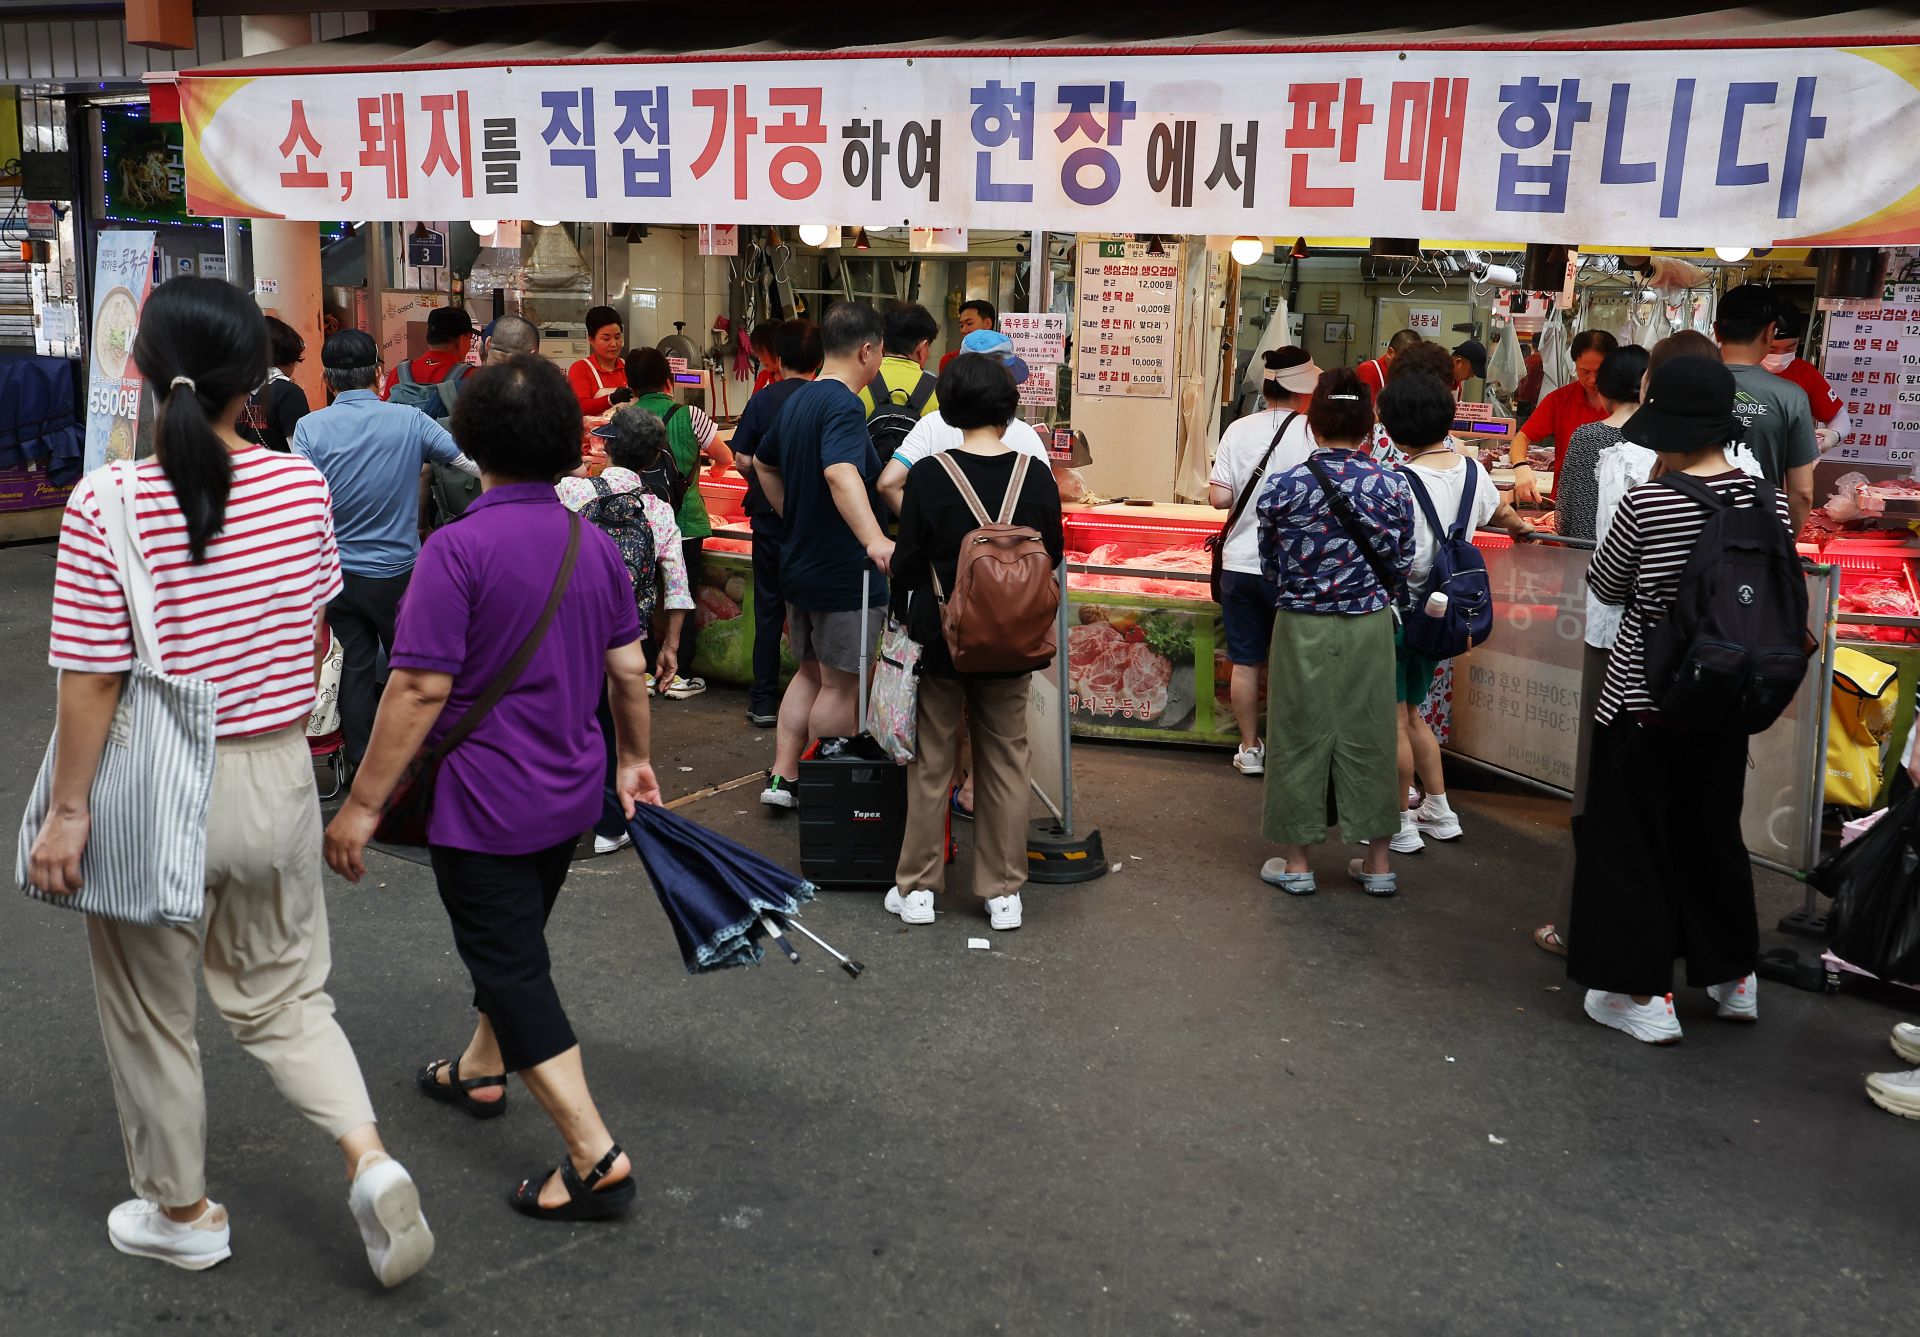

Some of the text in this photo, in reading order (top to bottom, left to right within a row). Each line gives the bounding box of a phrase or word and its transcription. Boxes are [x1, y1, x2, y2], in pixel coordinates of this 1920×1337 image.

[279, 90, 520, 201] 소,돼지를
[541, 86, 671, 198] 직접
[690, 85, 941, 202] 가공하여
[970, 80, 1258, 208] 현장에서
[422, 248, 430, 262] 3
[1084, 267, 1101, 275] 국내산
[1138, 280, 1173, 290] 12,000원
[1083, 293, 1099, 302] 국내산
[1137, 304, 1171, 314] 10,000원
[1004, 318, 1063, 329] 육우등심 특가
[1082, 320, 1098, 328] 국내산
[1410, 314, 1439, 328] 냉동실
[1134, 335, 1163, 344] 6,500원
[1827, 340, 1850, 349] 국내산
[1081, 346, 1097, 354] 국내산
[1131, 358, 1163, 367] 10,000원
[1080, 372, 1096, 380] 국내산
[1133, 375, 1163, 383] 6,000원
[1825, 372, 1848, 381] 국내산
[89, 387, 139, 420] 5900원
[853, 810, 881, 819] Tapex
